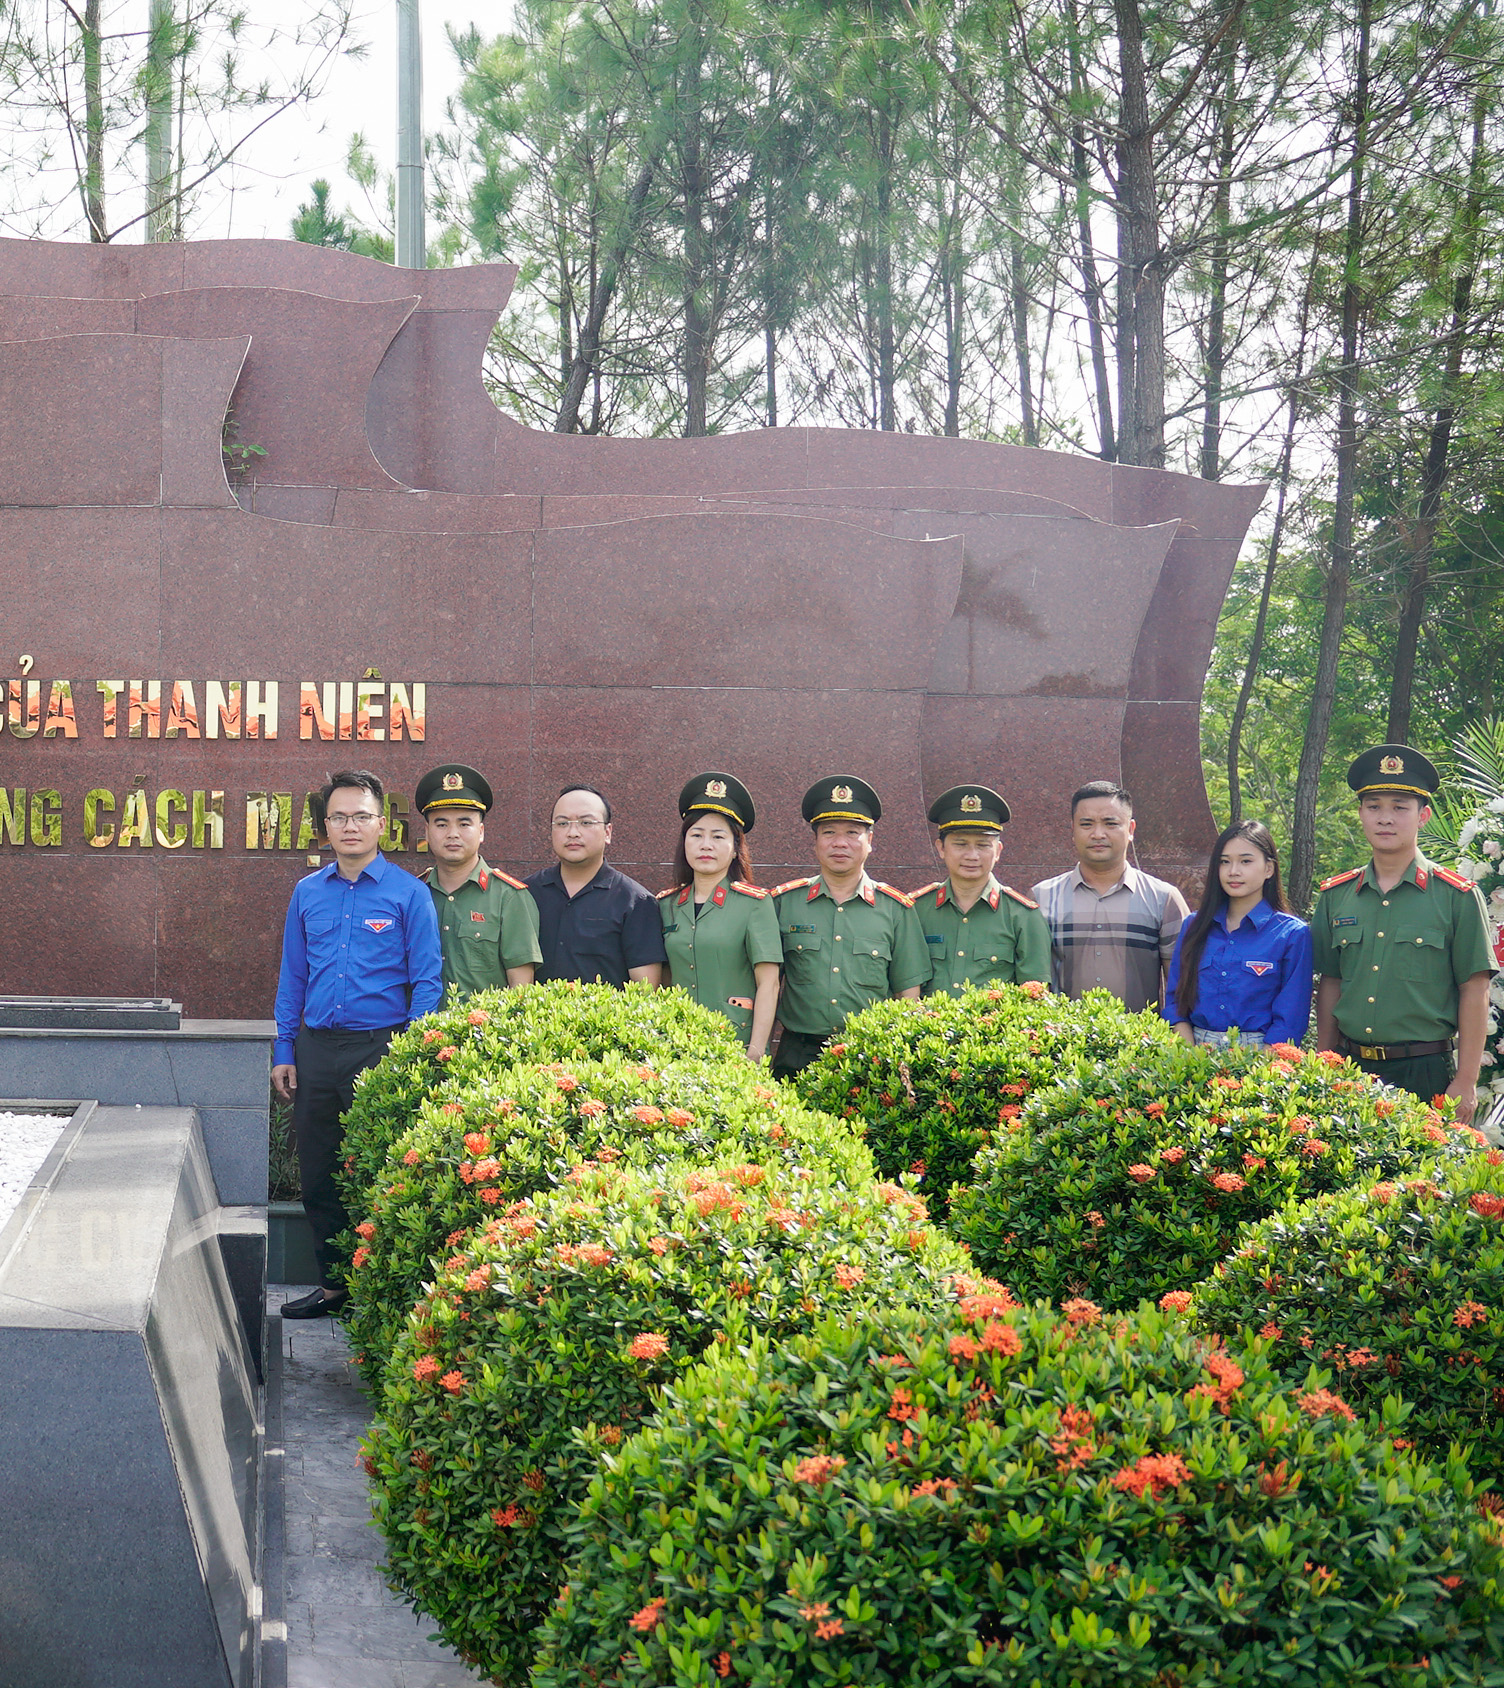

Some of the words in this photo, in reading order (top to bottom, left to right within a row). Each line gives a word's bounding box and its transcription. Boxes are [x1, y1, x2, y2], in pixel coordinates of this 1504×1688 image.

[96, 679, 279, 740] THANH
[298, 667, 426, 742] NIÊN
[83, 774, 225, 849] CÁCH
[246, 791, 429, 868] MẠG.
